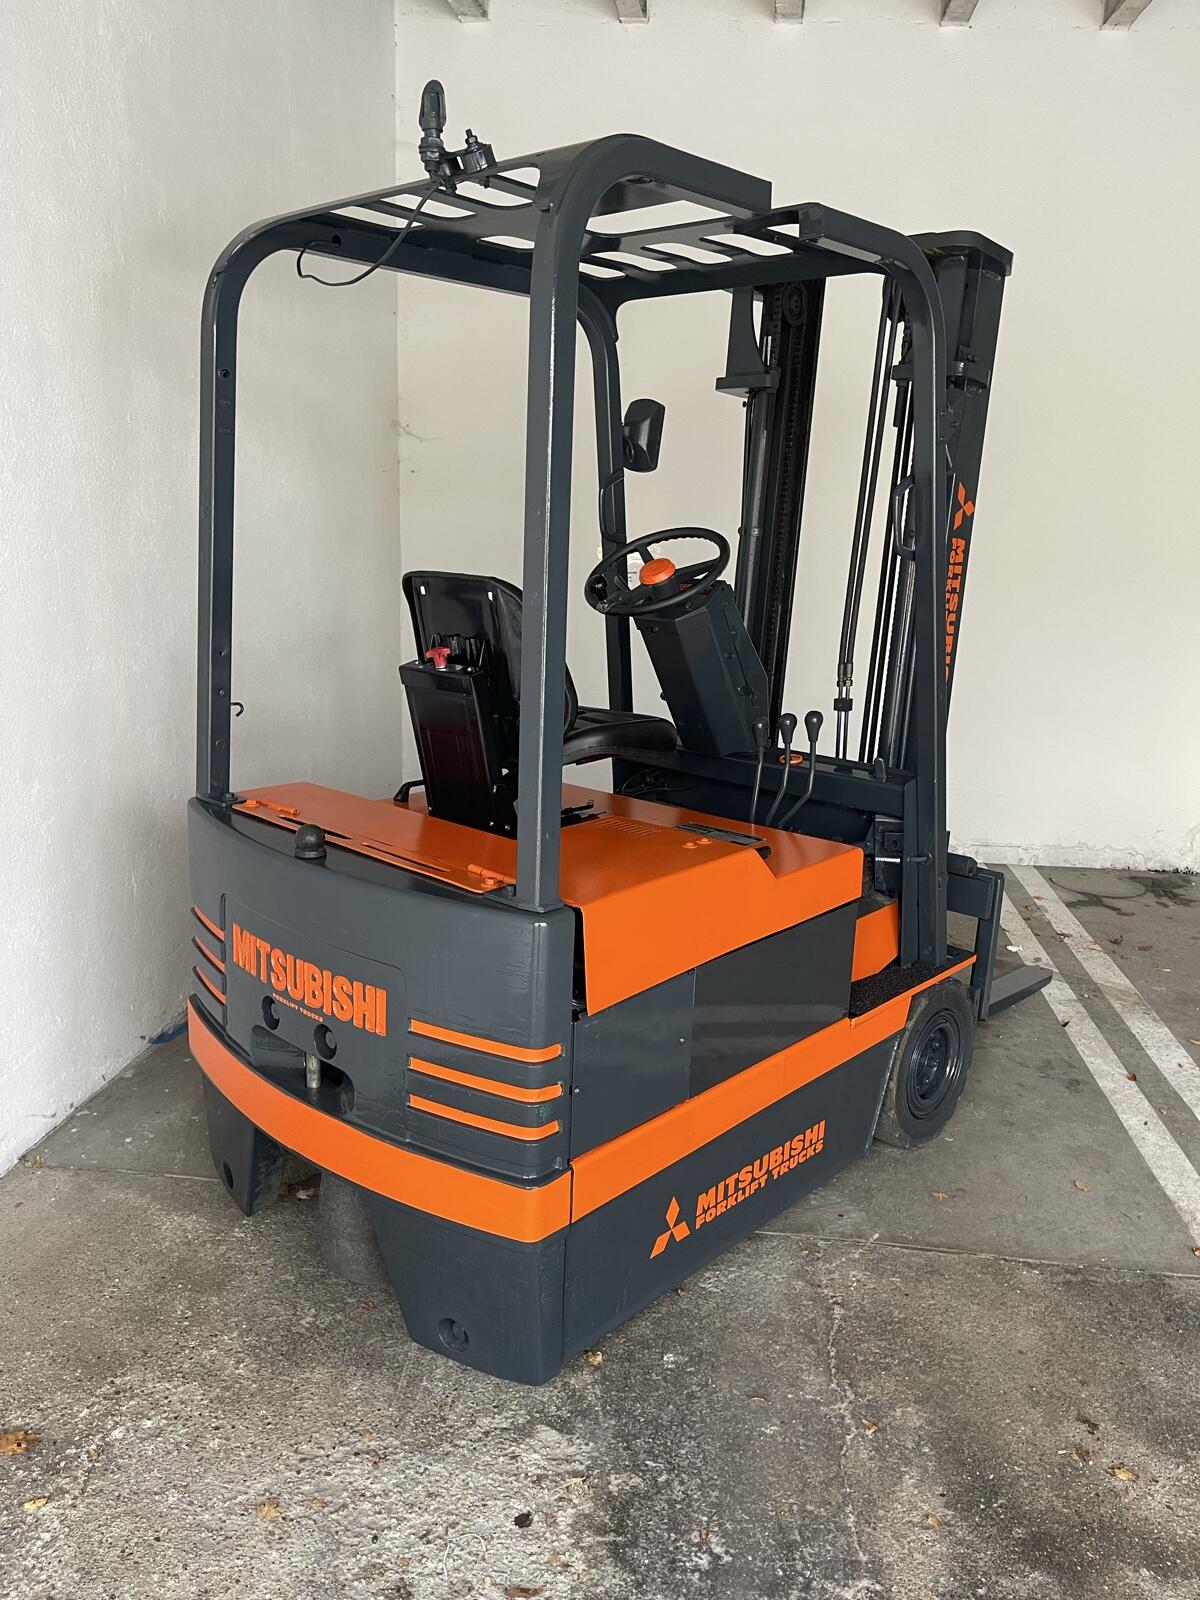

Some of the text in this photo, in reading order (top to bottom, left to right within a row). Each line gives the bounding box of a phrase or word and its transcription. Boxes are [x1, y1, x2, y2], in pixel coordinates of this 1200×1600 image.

[232, 921, 387, 1037] MITSUBISHI
[695, 1139, 824, 1230] FORKLIFT TRUCKS
[696, 1119, 826, 1217] MITSUBISHI
